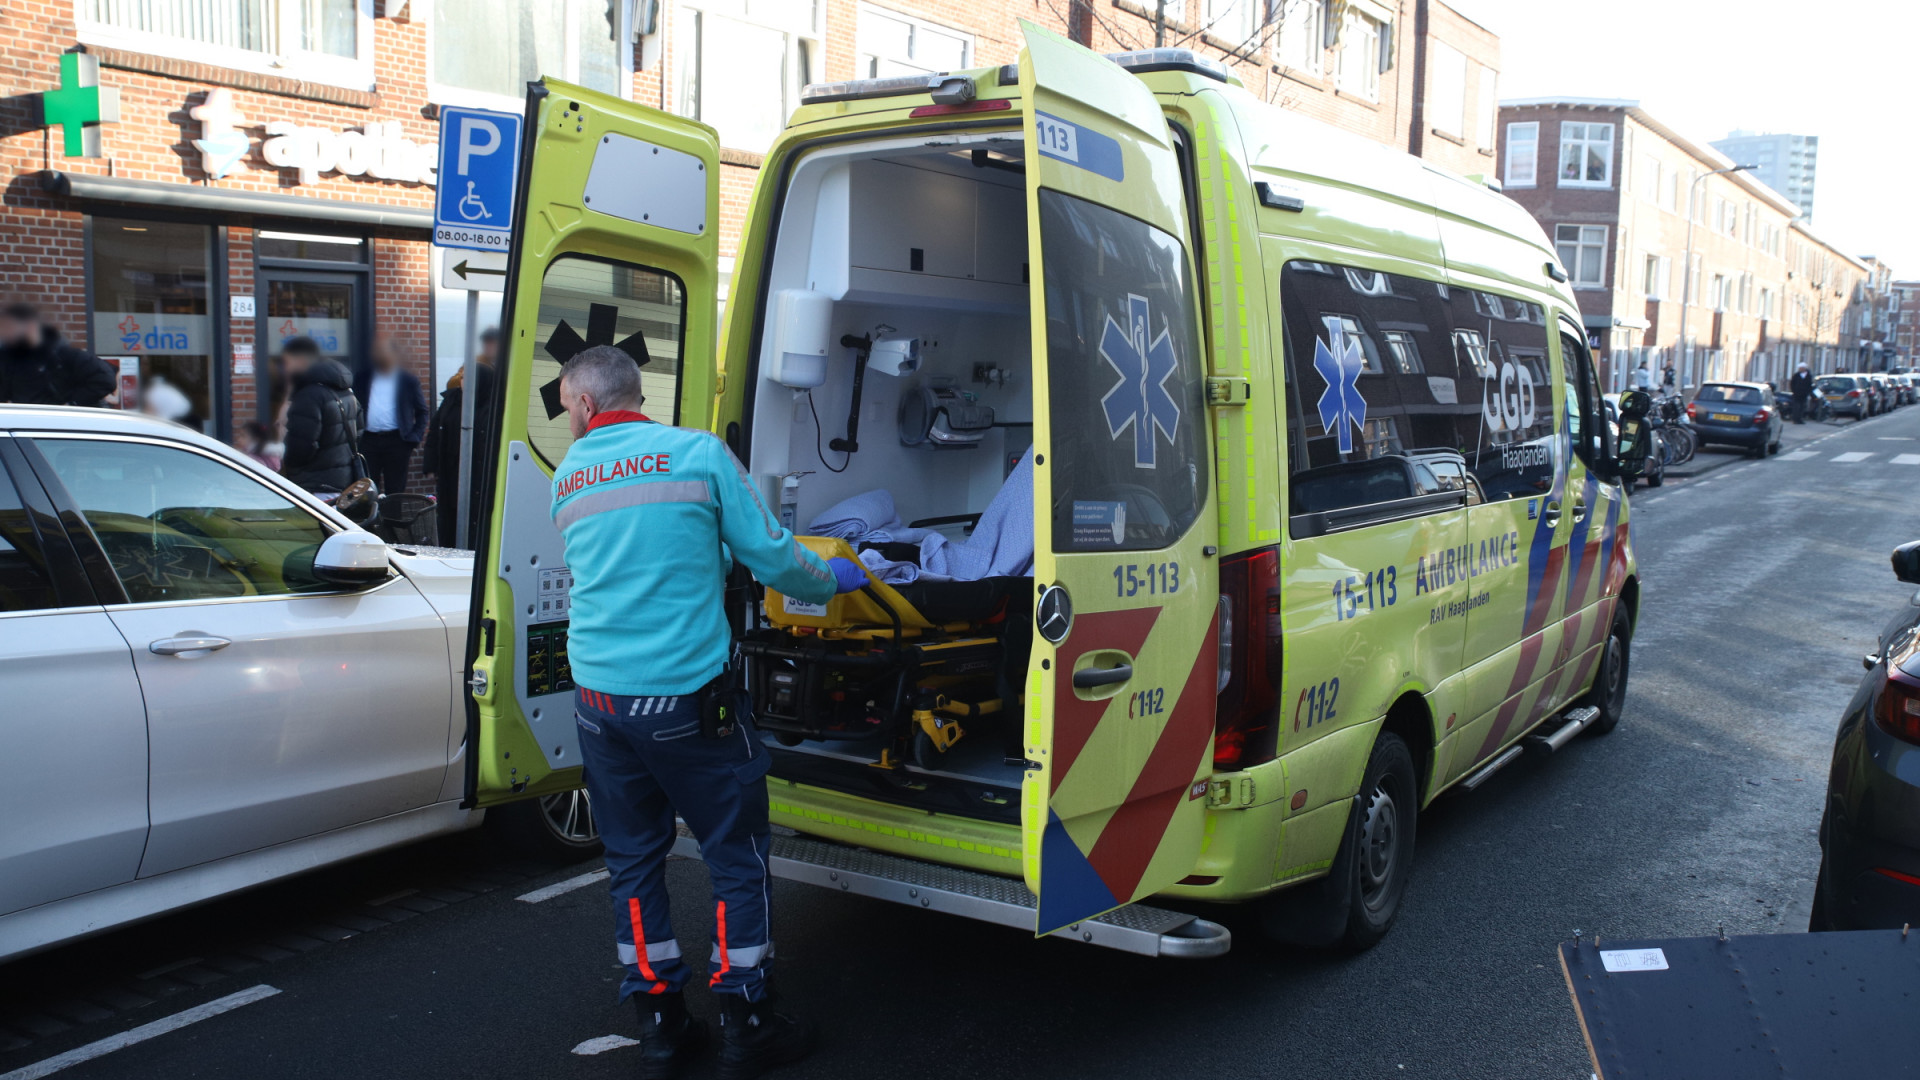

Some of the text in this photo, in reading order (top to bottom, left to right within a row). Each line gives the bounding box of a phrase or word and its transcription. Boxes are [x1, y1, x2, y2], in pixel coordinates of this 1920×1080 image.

[457, 117, 502, 176] P
[1036, 120, 1070, 152] 113
[437, 229, 501, 246] 08.00-18.00
[233, 301, 254, 313] 284
[144, 325, 189, 351] dna
[1484, 360, 1536, 431] GGD
[1502, 443, 1548, 475] Haaglanden
[556, 454, 671, 501] AMBULANCE
[1113, 562, 1179, 598] 15-113
[1332, 531, 1518, 622] 15-113 AMBULANCE
[1430, 590, 1490, 625] RAV Haaglanden
